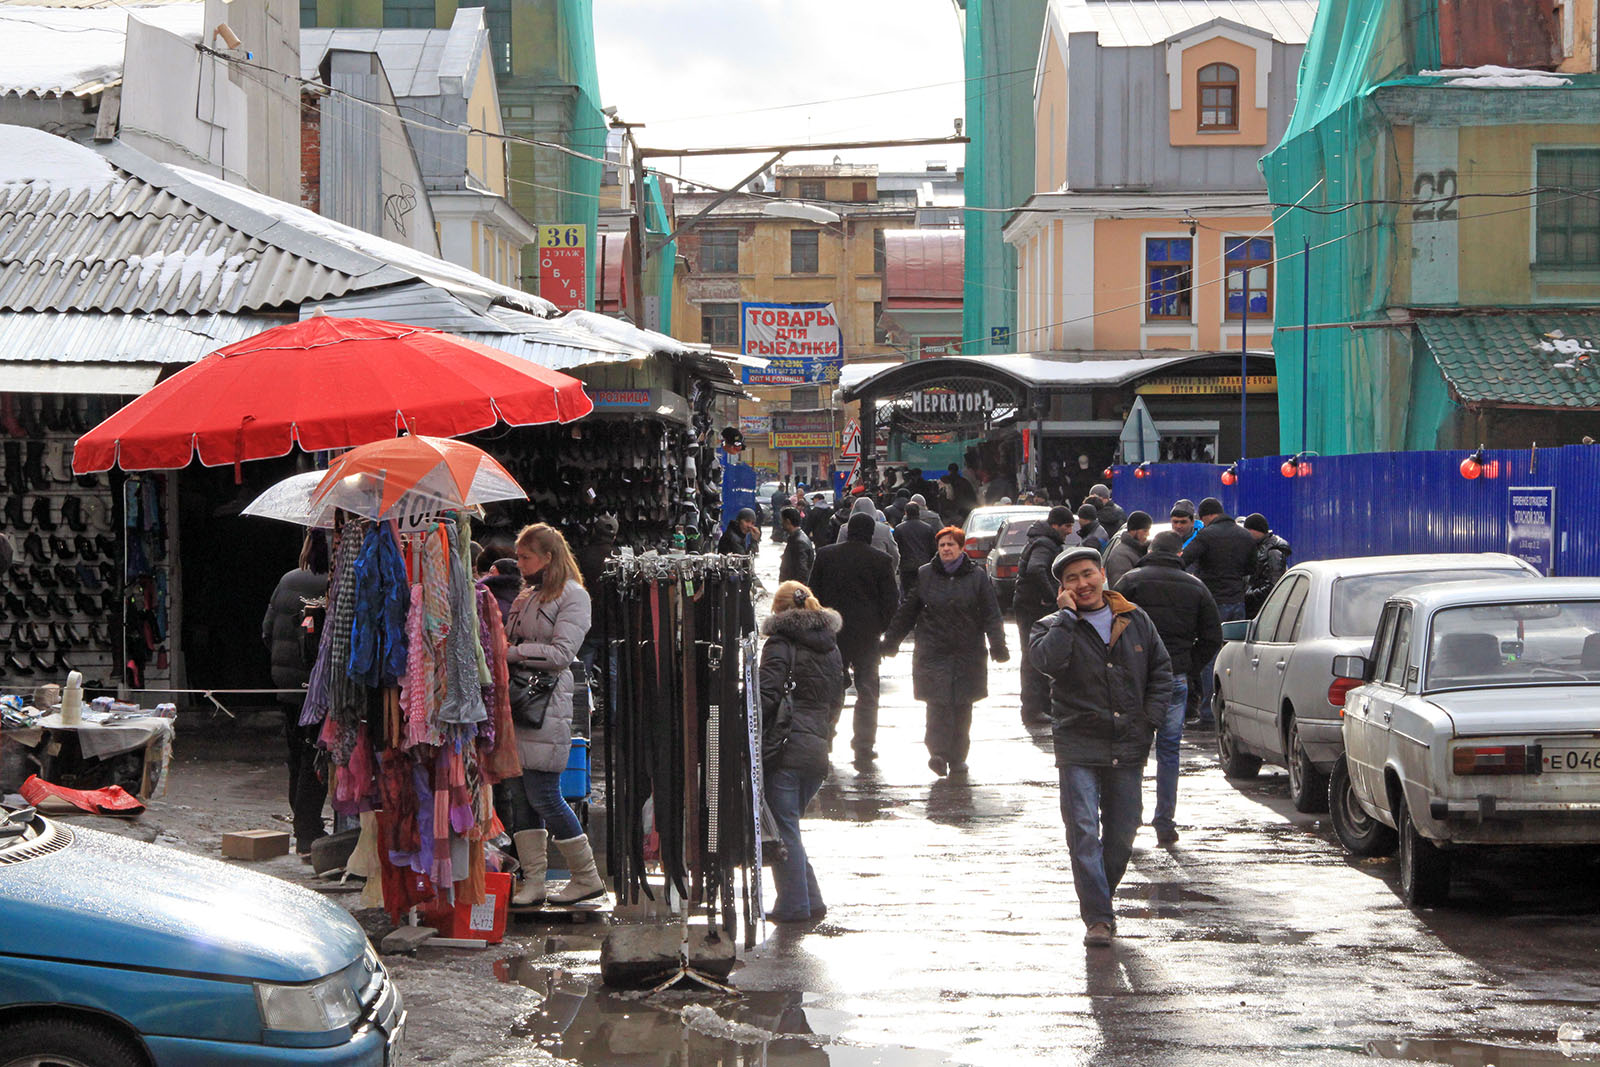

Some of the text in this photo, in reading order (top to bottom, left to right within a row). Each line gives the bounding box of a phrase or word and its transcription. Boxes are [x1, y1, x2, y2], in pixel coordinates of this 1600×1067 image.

[1413, 168, 1457, 220] 22
[547, 228, 578, 247] 36
[542, 258, 585, 308] ОБУВЬ
[748, 310, 835, 327] ТОВАРЫ
[775, 328, 807, 340] ДЛЯ
[747, 340, 837, 355] РЫБАЛКИ
[1253, 376, 1272, 384] БУСЫ
[599, 391, 649, 404] РОЗНИЦА
